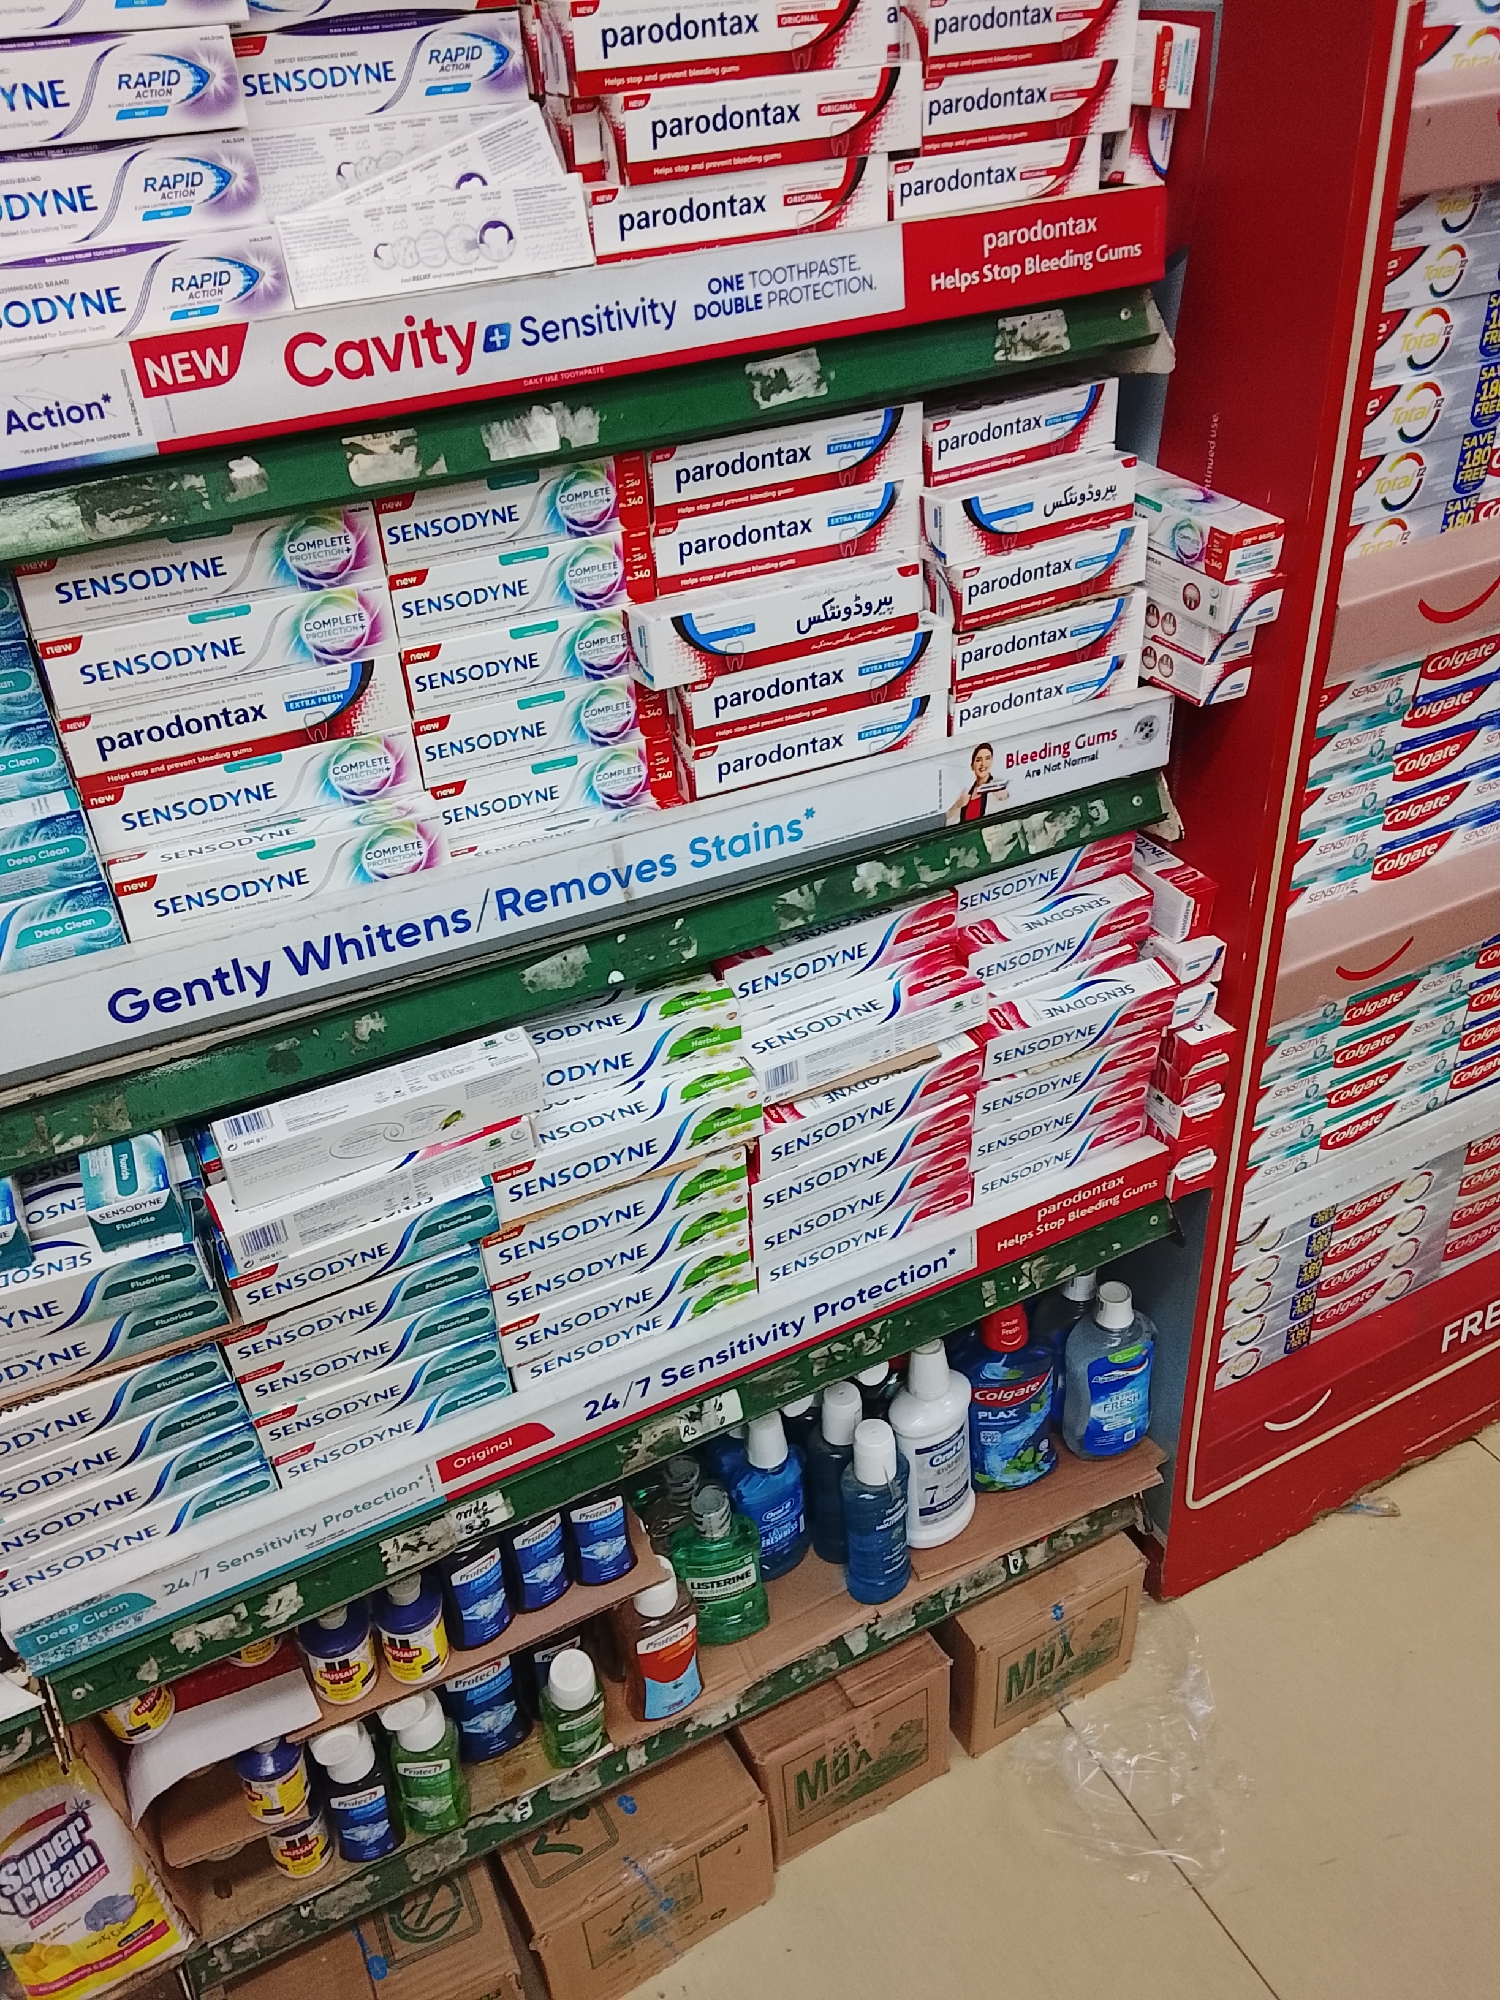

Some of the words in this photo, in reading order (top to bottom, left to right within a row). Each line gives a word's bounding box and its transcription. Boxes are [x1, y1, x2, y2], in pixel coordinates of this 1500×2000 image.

[780, 14, 818, 25] ORIGINAL
[602, 13, 759, 59] parodontax
[428, 45, 482, 64] RAPID
[243, 61, 396, 98] SENSODYNE
[439, 63, 471, 72] ACTION
[604, 76, 625, 87] Helps
[626, 74, 643, 84] stop
[659, 69, 687, 82] prevent
[688, 66, 719, 77] bleeding
[720, 64, 740, 74] gums
[117, 70, 180, 90] RAPID
[135, 88, 172, 98] ACTION
[628, 99, 646, 107] NEW
[928, 86, 1047, 125] parodontax
[786, 193, 822, 203] ORIGINAL
[618, 194, 766, 242] parodontax
[983, 216, 1097, 258] parodontax
[412, 273, 431, 282] RELIEF
[708, 272, 745, 294] ONE
[749, 255, 862, 288] TOOTHPASTE.
[930, 266, 980, 293] Helps
[983, 259, 1022, 284] Stop
[1025, 250, 1093, 275] Bleeding
[1096, 242, 1142, 262] Gums
[1423, 262, 1457, 282] Total
[694, 294, 763, 322] DOUBLE
[767, 274, 877, 310] PROTECTION.
[520, 296, 677, 348] Sensitivity
[284, 314, 477, 389] Cavity
[143, 346, 228, 388] NEW
[523, 377, 543, 387] DAILY
[545, 373, 559, 384] USE
[561, 366, 605, 382] TOOTHPASTE
[1390, 404, 1430, 426] Total
[938, 415, 1042, 460] parodontax
[1463, 430, 1494, 450] SAVE
[675, 444, 811, 493] parodontax
[1457, 465, 1487, 482] FREE
[559, 487, 610, 504] COMPLETE
[1375, 475, 1414, 495] Total
[387, 504, 519, 545] SENSODYNE
[830, 516, 852, 525] EXTRA
[854, 511, 875, 520] FRESH
[287, 534, 350, 553] COMPLETE
[396, 576, 417, 586] new
[45, 642, 72, 654] new
[961, 627, 1068, 671] parodontax
[714, 668, 844, 717] parodontax
[1350, 674, 1405, 700] SENSITIVE
[289, 698, 314, 710] EXTRA
[317, 692, 344, 705] FRESH
[67, 720, 85, 731] NEW
[425, 721, 547, 762] SENSODYNE
[1006, 739, 1070, 769] Bleeding
[1075, 728, 1118, 750] Gums
[107, 773, 129, 783] Helps
[131, 767, 148, 780] stop
[150, 765, 165, 774] and
[166, 759, 196, 773] prevent
[198, 752, 230, 764] bleeding
[232, 746, 252, 758] gums
[1025, 767, 1041, 779] Are
[1044, 762, 1061, 774] Not
[1064, 750, 1099, 767] Normal
[1395, 742, 1460, 776] Colgate
[596, 765, 642, 782] COMPLETE
[437, 787, 456, 796] new
[121, 781, 277, 832] SENSODYNE
[1317, 830, 1369, 856] SENSITIVE
[7, 854, 33, 868] Deep
[36, 845, 70, 860] Clean
[1093, 851, 1119, 863] Original
[1022, 897, 1111, 932] SENSODYNE
[1109, 918, 1135, 931] Original
[34, 926, 63, 939] Deep
[64, 916, 95, 932] Clean
[107, 957, 271, 1024] Gently
[1344, 989, 1403, 1022] Colgate
[751, 999, 885, 1055] SENSODYNE
[1412, 1012, 1455, 1034] SENSITIVE
[691, 1034, 721, 1048] Herbal
[994, 1023, 1097, 1061] SENSODYNE
[1273, 1074, 1320, 1098] SENSITIVE
[1330, 1071, 1388, 1104] Colgate
[713, 1114, 742, 1128] Herbal
[497, 1171, 510, 1182] new
[511, 1165, 529, 1177] look
[508, 1138, 658, 1202] SENSODYNE
[980, 1149, 1073, 1195] SENSODYNE
[1037, 1176, 1125, 1222] parodontax
[438, 1213, 472, 1232] Fluoride
[701, 1217, 728, 1232] Herbal
[764, 1190, 886, 1250] SENSODYNE
[997, 1227, 1034, 1252] Helps
[1036, 1216, 1065, 1236] Stop
[1068, 1193, 1120, 1222] Bleeding
[1123, 1179, 1158, 1199] Gums
[1327, 1221, 1388, 1258] Colgate
[1316, 1287, 1375, 1323] Colgate
[155, 1310, 194, 1326] Fluoride
[515, 1287, 654, 1351] SENSODYNE
[255, 1341, 392, 1398] SENSODYNE
[446, 1358, 478, 1374] Fluoride
[582, 1376, 652, 1423] 24/7
[661, 1316, 805, 1388] Sensitivity
[974, 1380, 1040, 1402] Colgate
[978, 1408, 1018, 1420] PLAX
[1103, 1394, 1140, 1414] FRESH
[453, 1435, 513, 1470] Original
[924, 1486, 939, 1505] 7
[163, 1568, 210, 1598] 24/7
[216, 1523, 316, 1574] Sensitivity
[691, 1569, 752, 1591] LISTERINE
[35, 1622, 78, 1648] Deep
[82, 1599, 130, 1626] Clean
[321, 1666, 360, 1683] HUSSAIN
[281, 1837, 319, 1859] HUSSAIN
